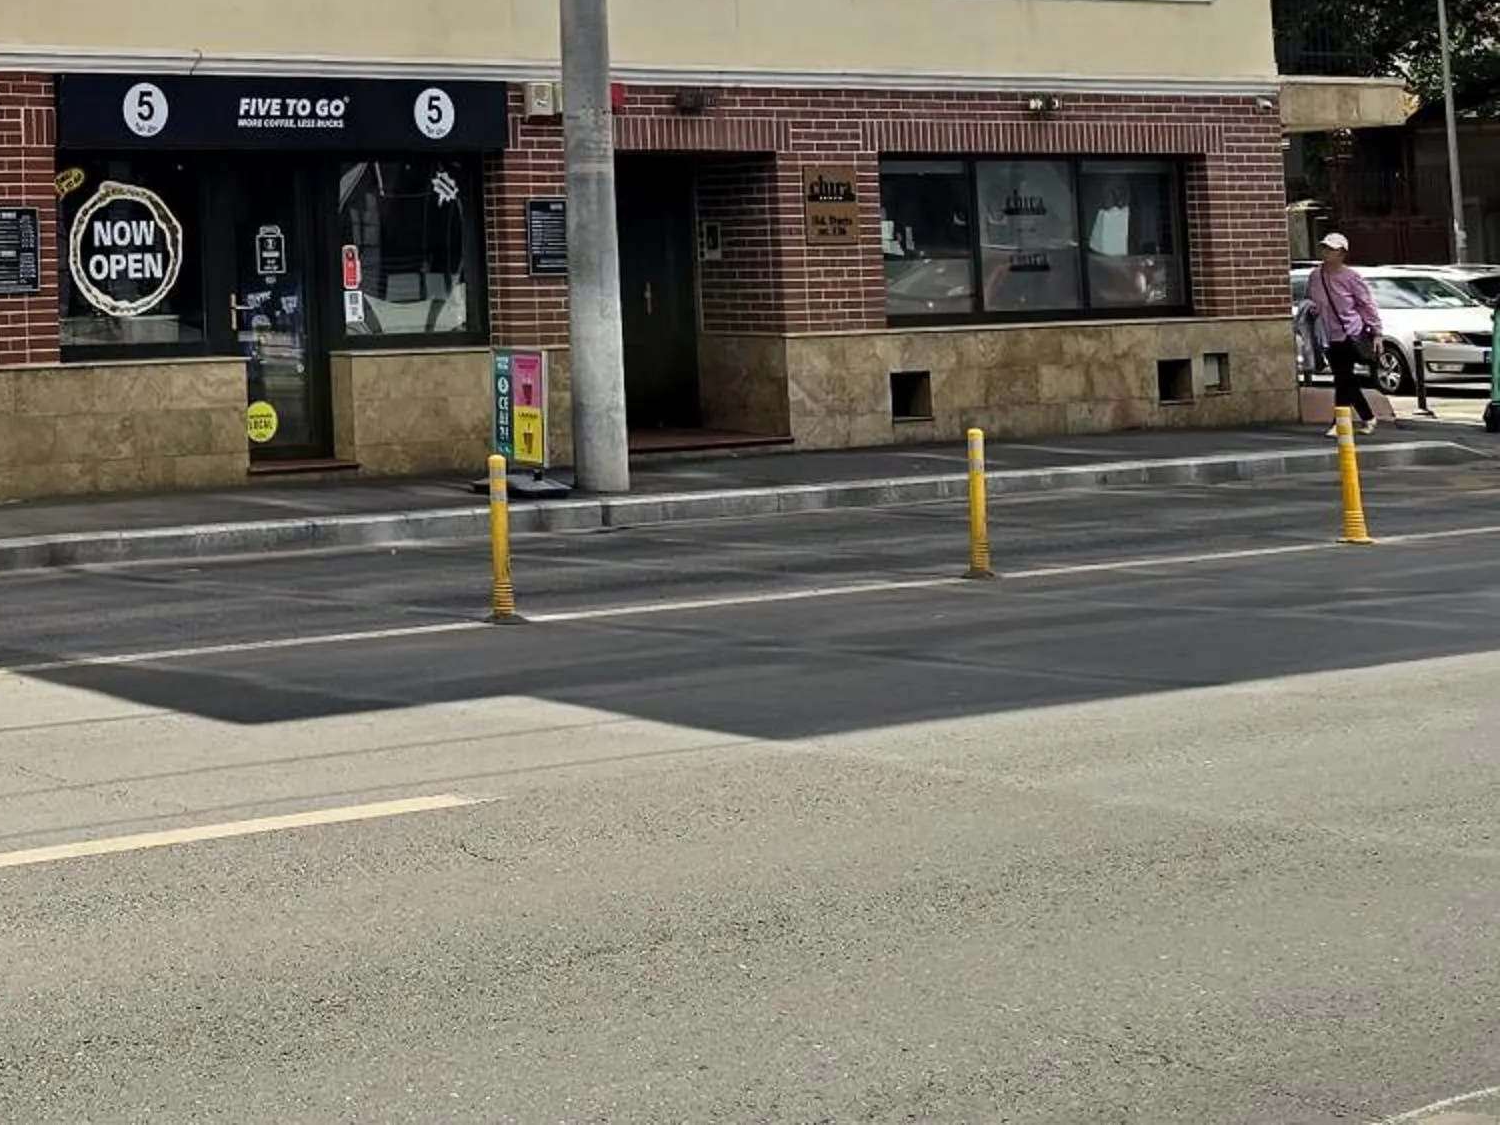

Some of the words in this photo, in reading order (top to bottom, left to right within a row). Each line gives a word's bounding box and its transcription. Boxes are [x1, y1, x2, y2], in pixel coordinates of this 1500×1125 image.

[138, 91, 154, 121] 5
[240, 98, 282, 116] FIVE
[286, 98, 311, 116] TO
[315, 99, 345, 117] GO
[428, 96, 442, 124] 5
[93, 220, 154, 247] NOW
[88, 252, 163, 280] OPEN
